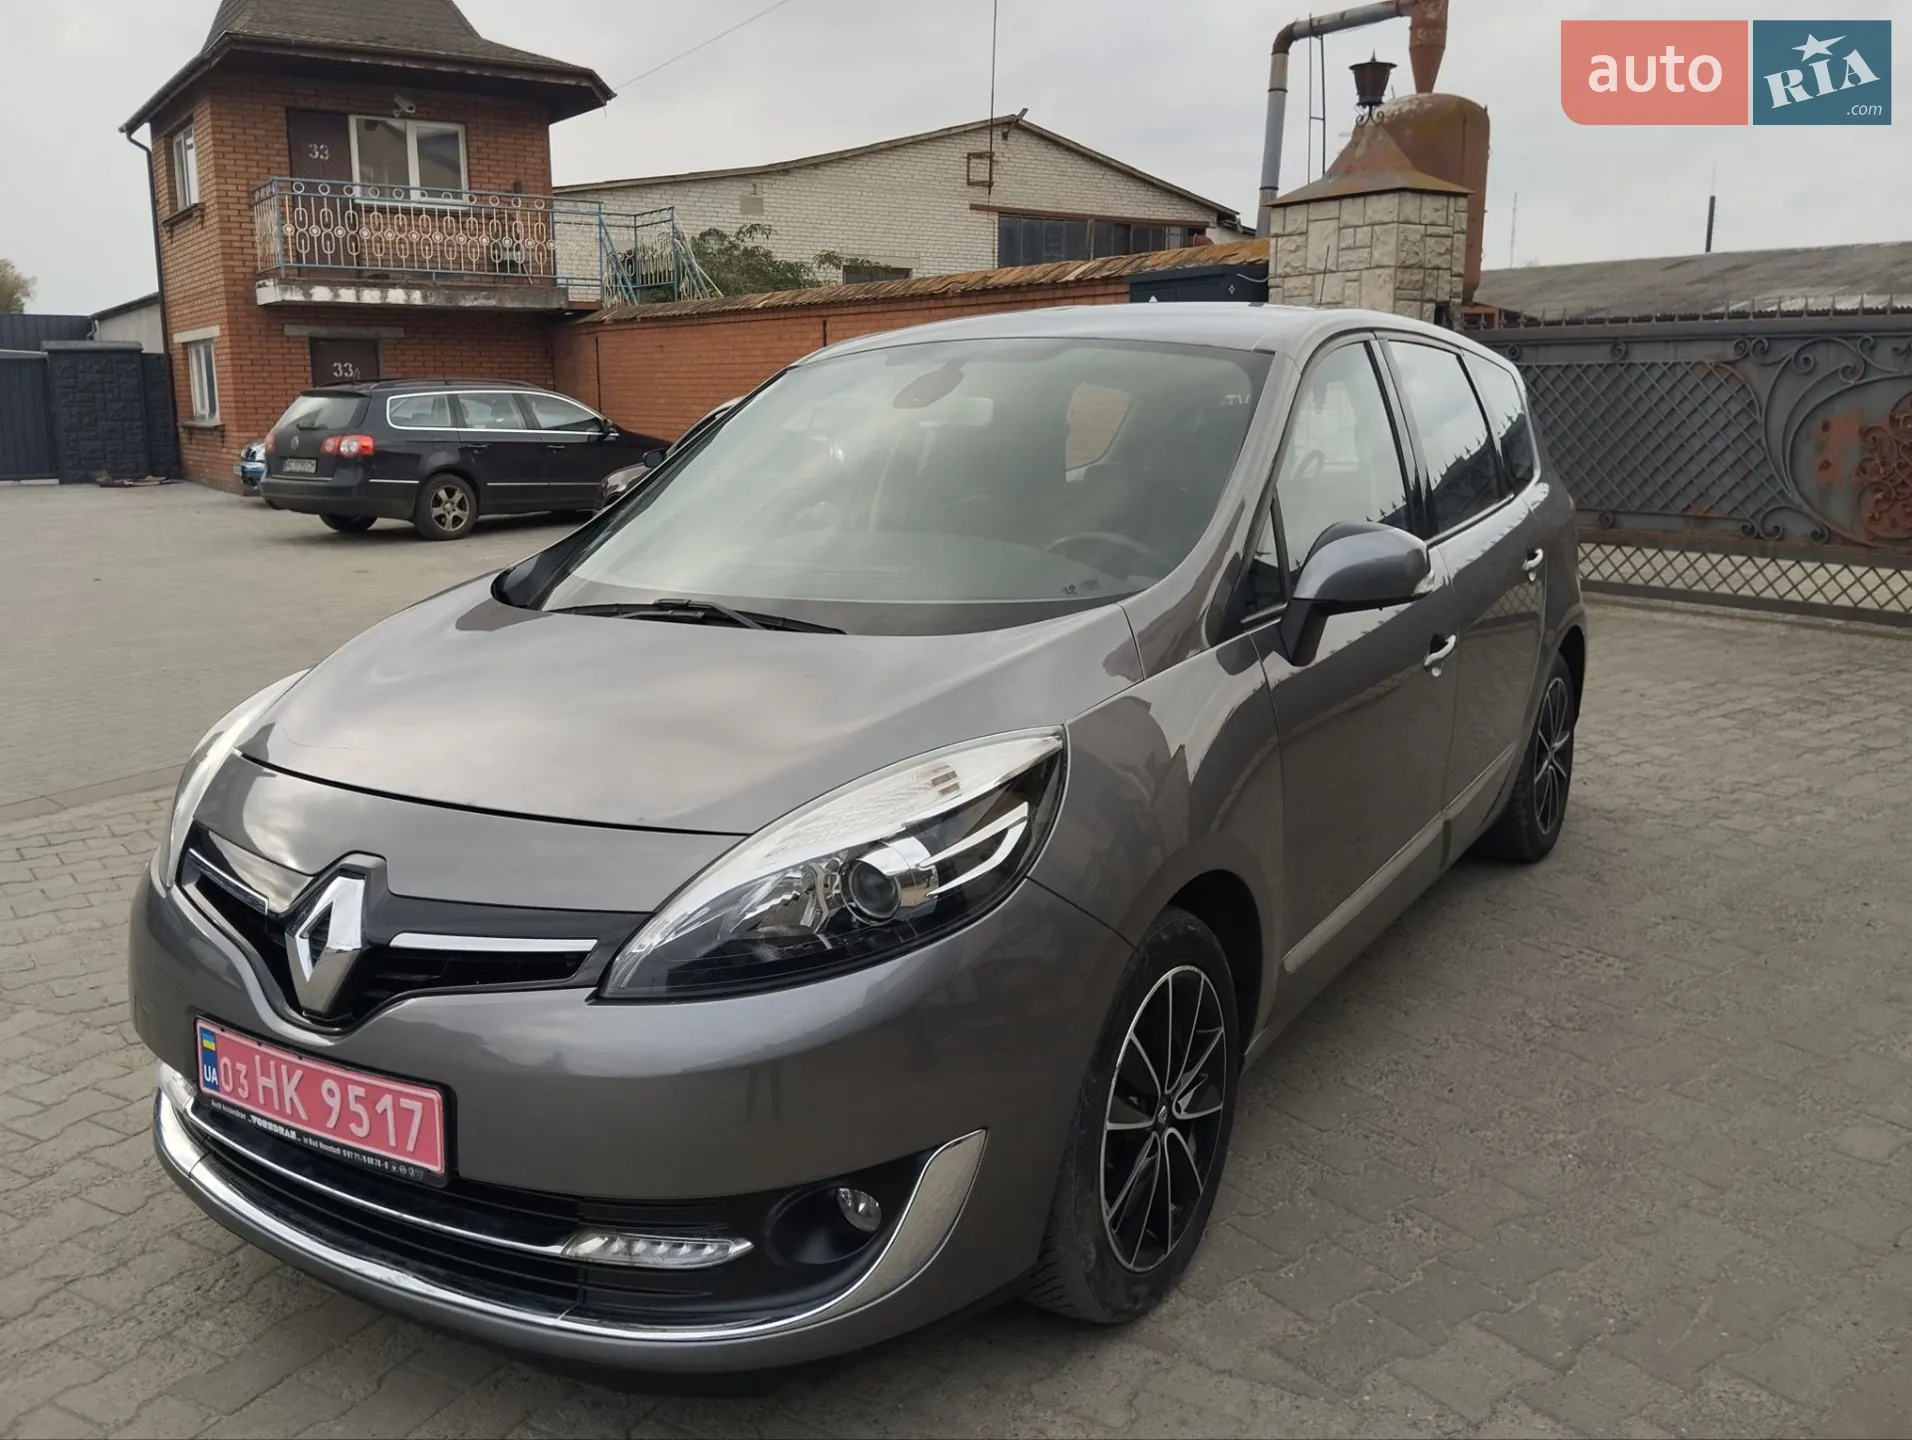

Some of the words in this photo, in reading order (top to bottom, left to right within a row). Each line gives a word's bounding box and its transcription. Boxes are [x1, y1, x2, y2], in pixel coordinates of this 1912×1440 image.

[309, 143, 330, 160] 33
[203, 1064, 219, 1086] UA
[254, 1054, 308, 1122] HK
[321, 1078, 423, 1153] 9517
